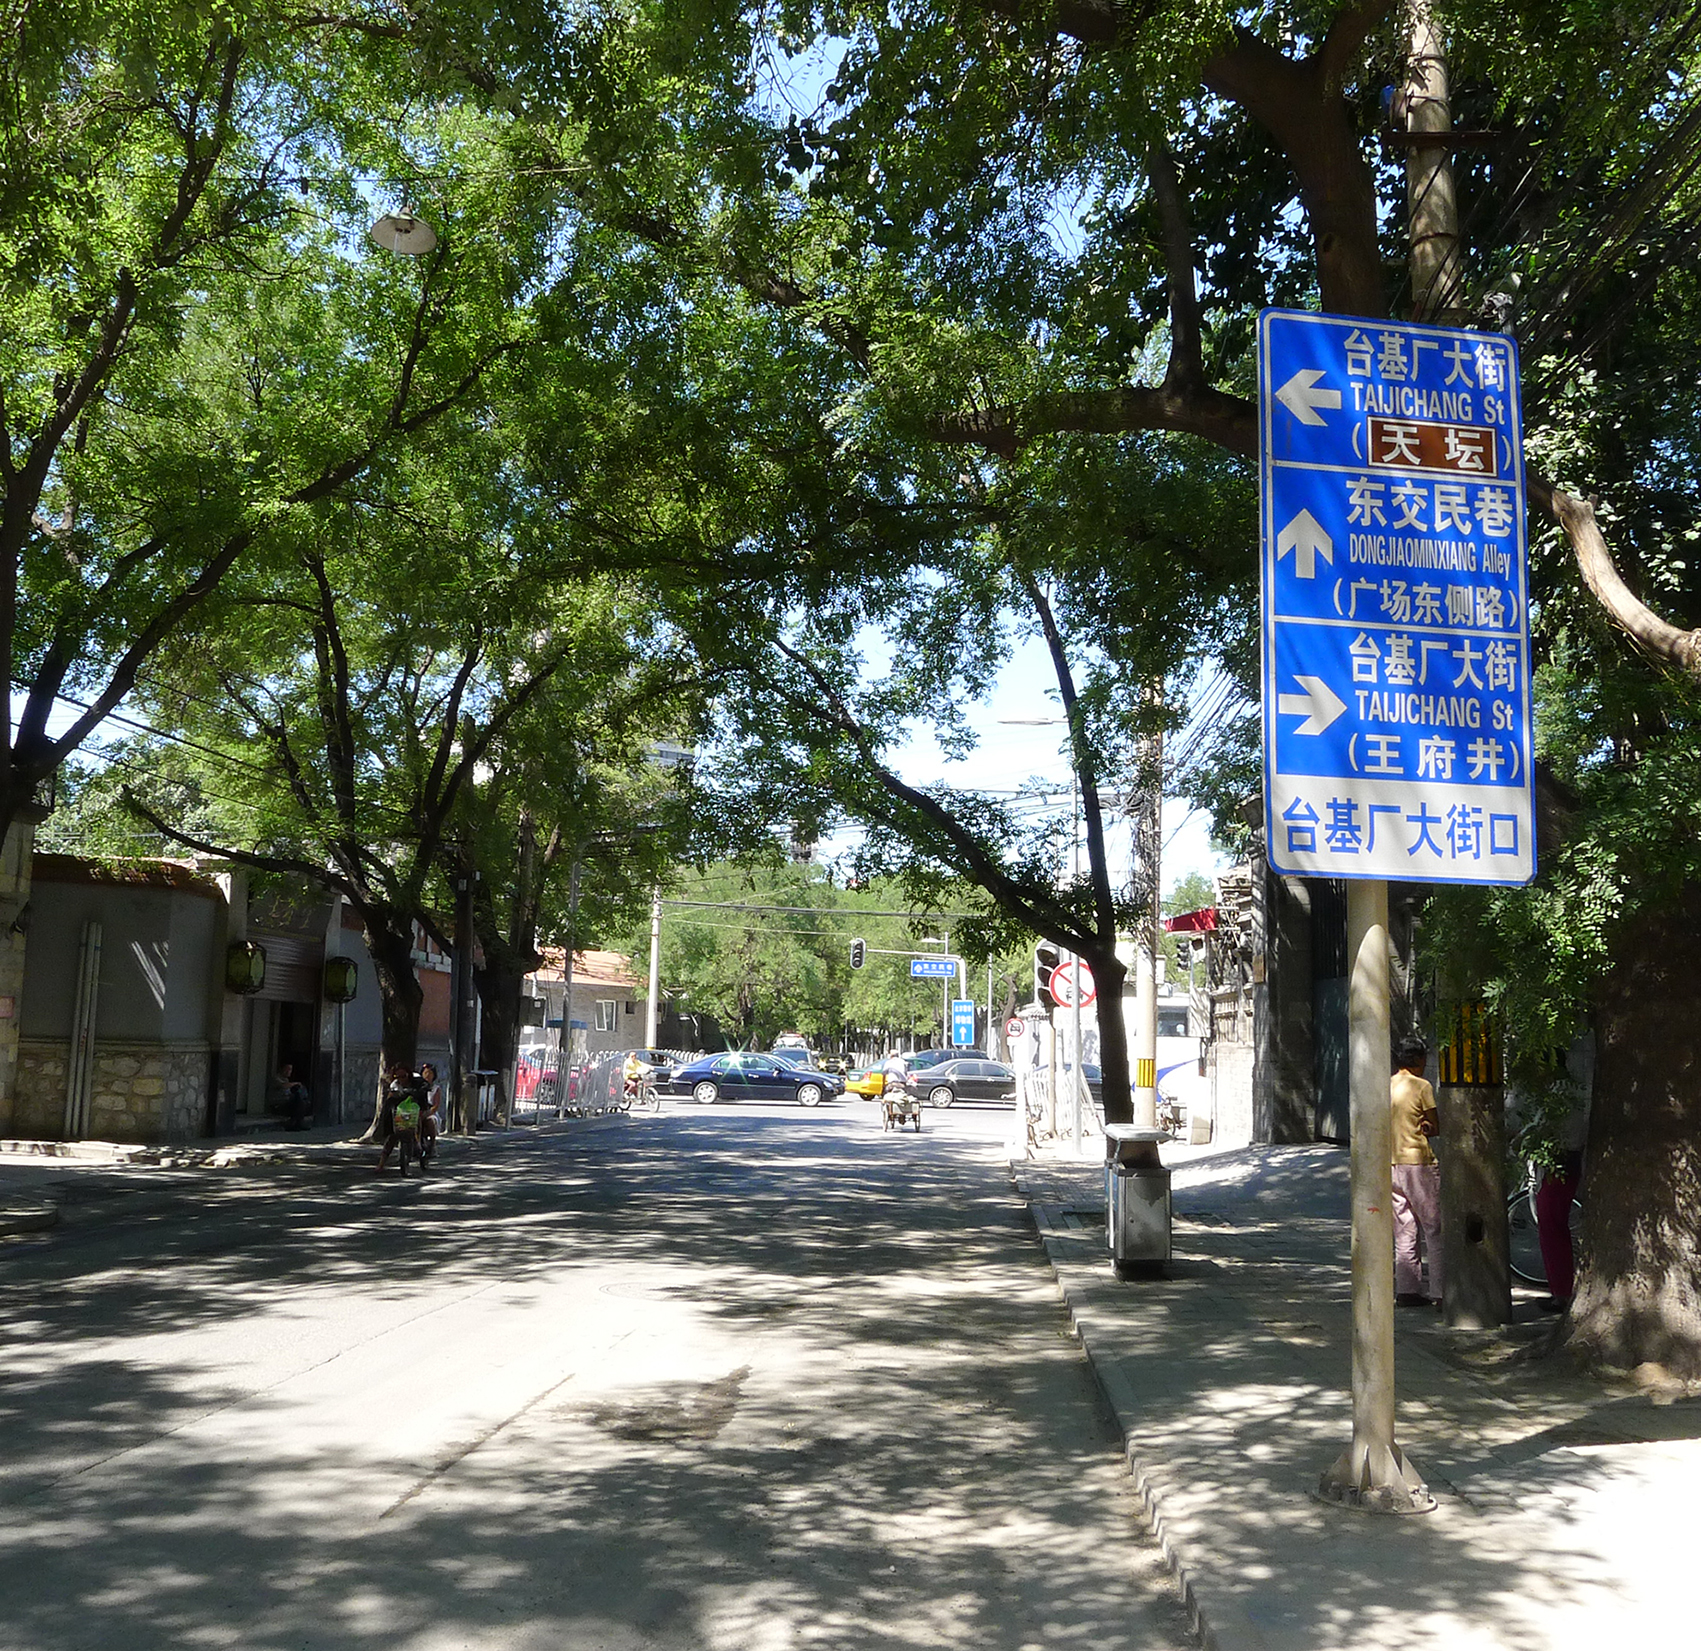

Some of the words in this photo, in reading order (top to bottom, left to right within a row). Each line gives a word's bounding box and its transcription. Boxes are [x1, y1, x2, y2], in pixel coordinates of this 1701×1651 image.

[1343, 328, 1506, 392] 台基厂大街
[1350, 381, 1472, 421] TAIJICHANG
[1483, 395, 1505, 425] St
[1346, 476, 1513, 538] 东交民巷
[1350, 533, 1476, 572] DONGJIAOMINXIANG
[1482, 544, 1511, 581] Alley
[1348, 631, 1517, 692] 台基厂大街
[1355, 690, 1481, 728] TAIJICHANG
[1492, 699, 1514, 731] St
[1282, 796, 1519, 860] 台基厂大街口
